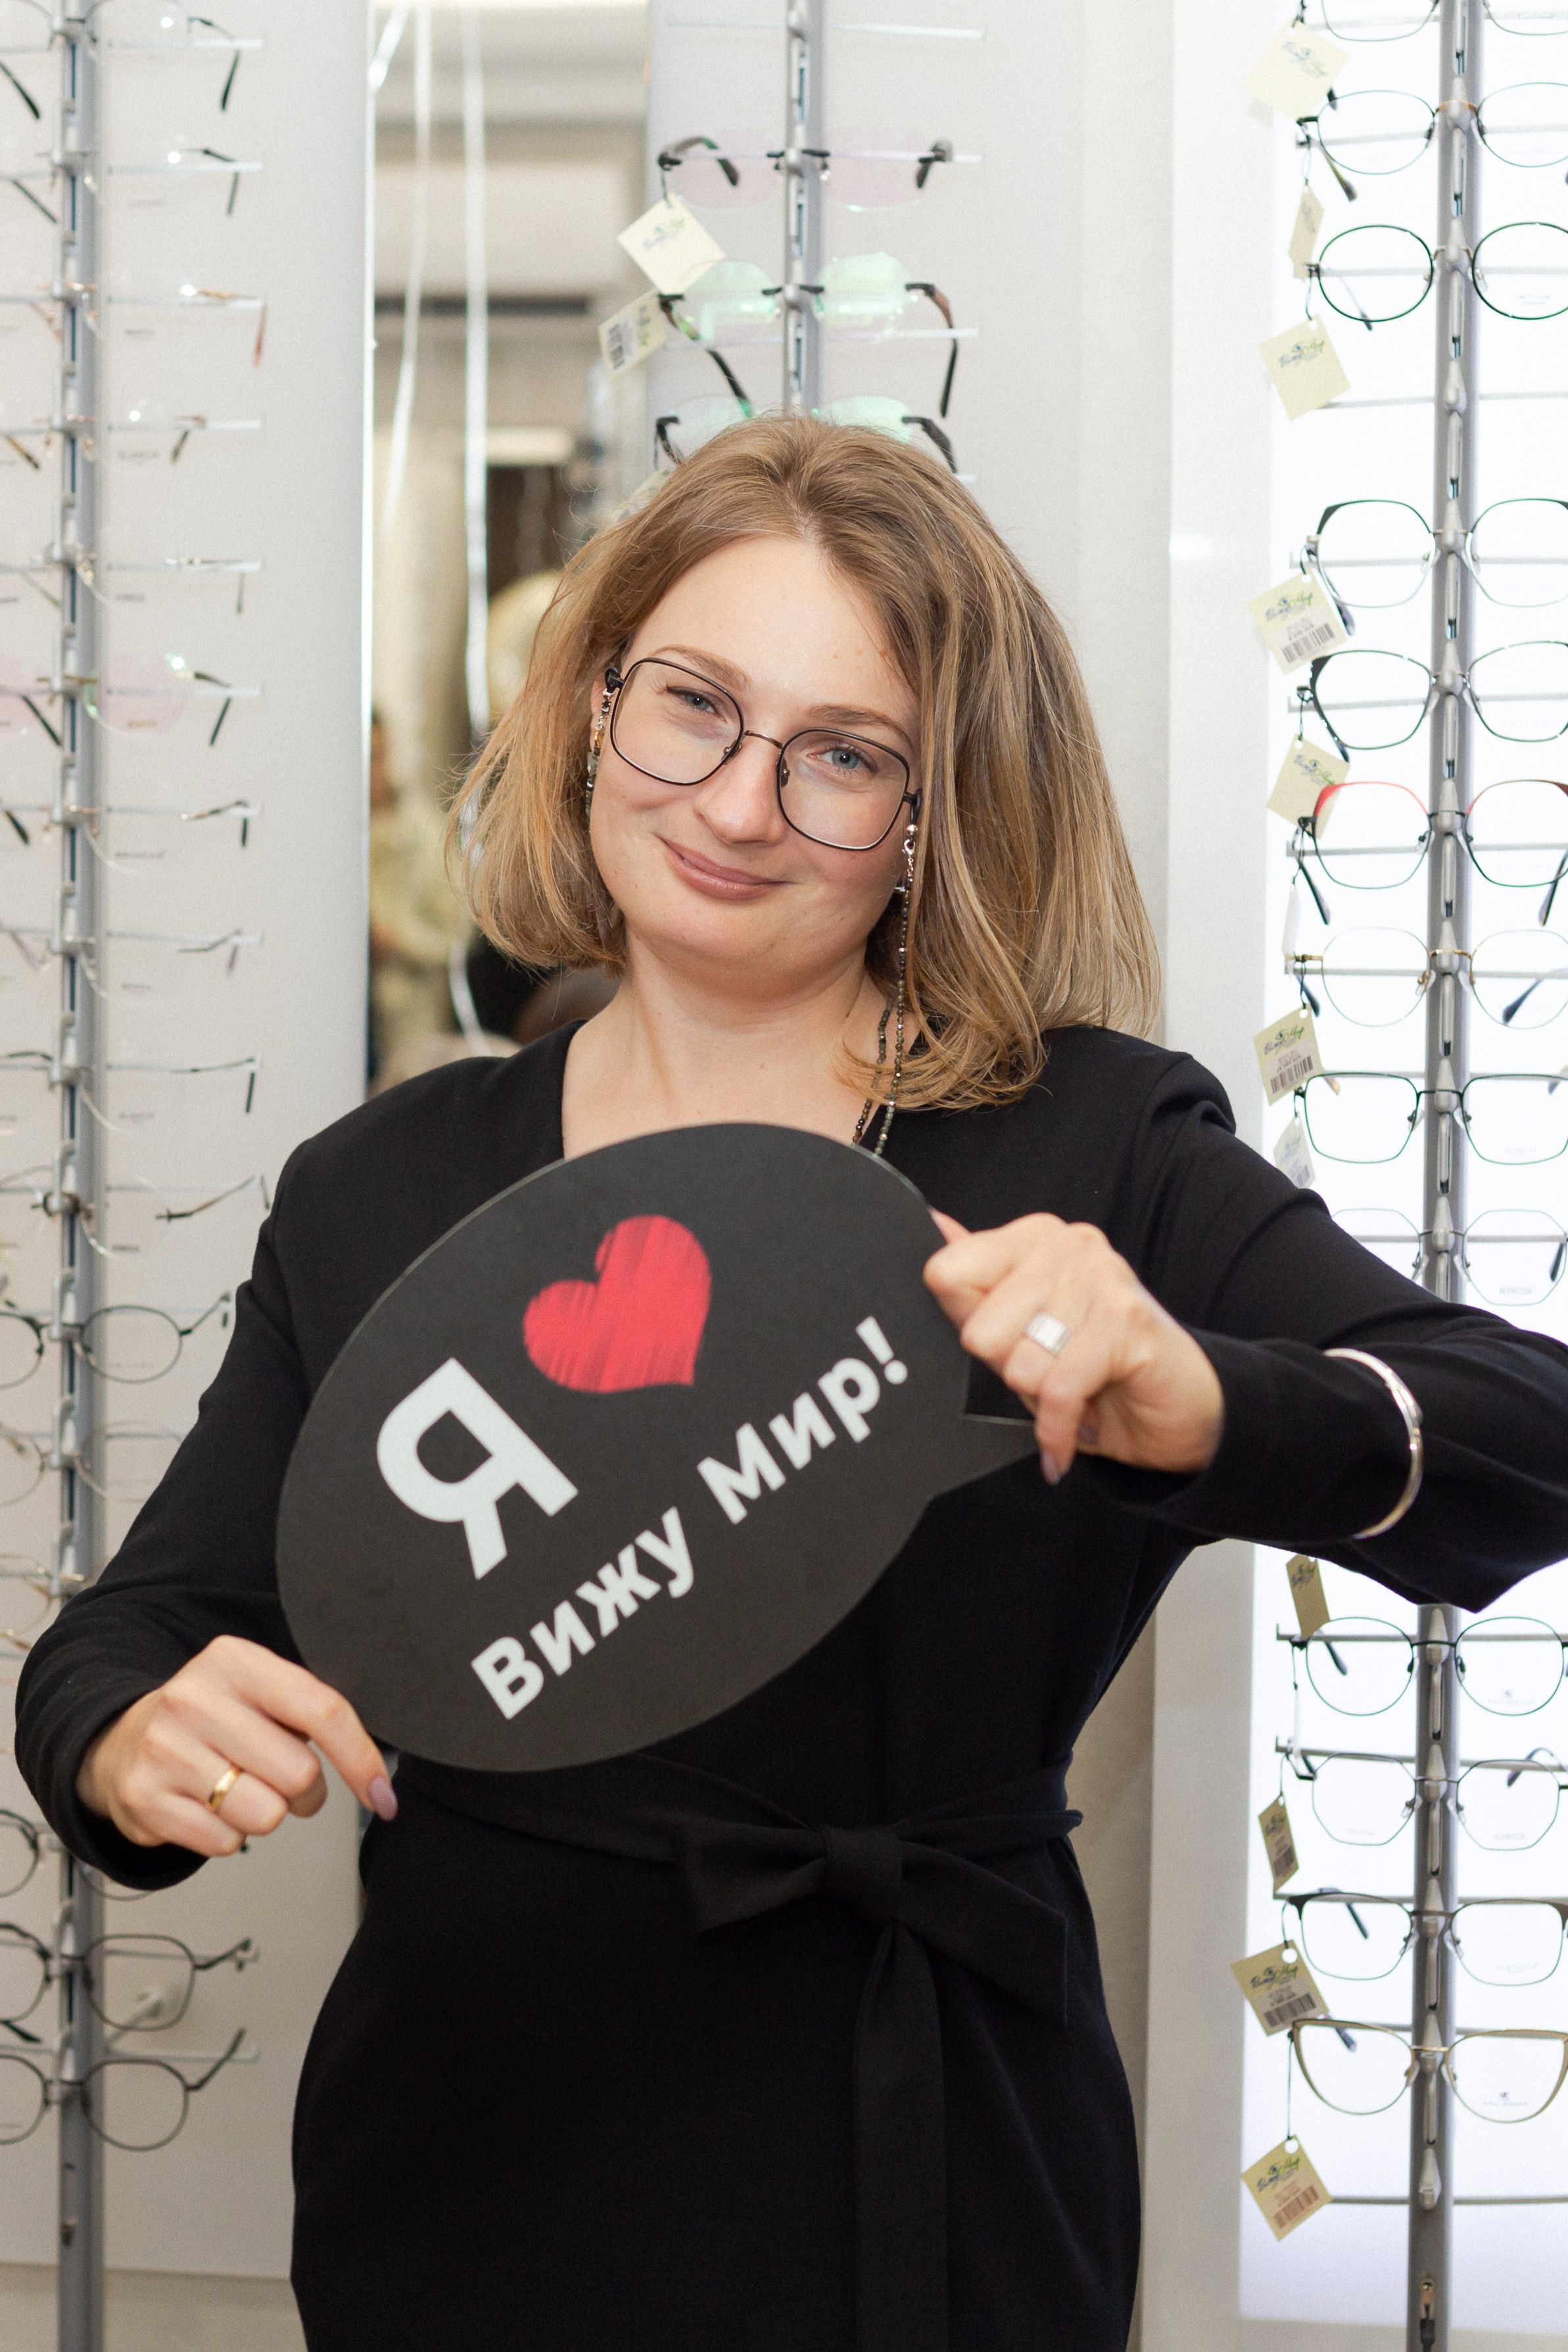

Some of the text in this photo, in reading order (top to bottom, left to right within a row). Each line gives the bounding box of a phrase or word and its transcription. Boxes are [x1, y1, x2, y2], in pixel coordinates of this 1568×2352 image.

[377, 1358, 577, 1579] Я
[472, 1317, 907, 1719] Вижу Мир!
